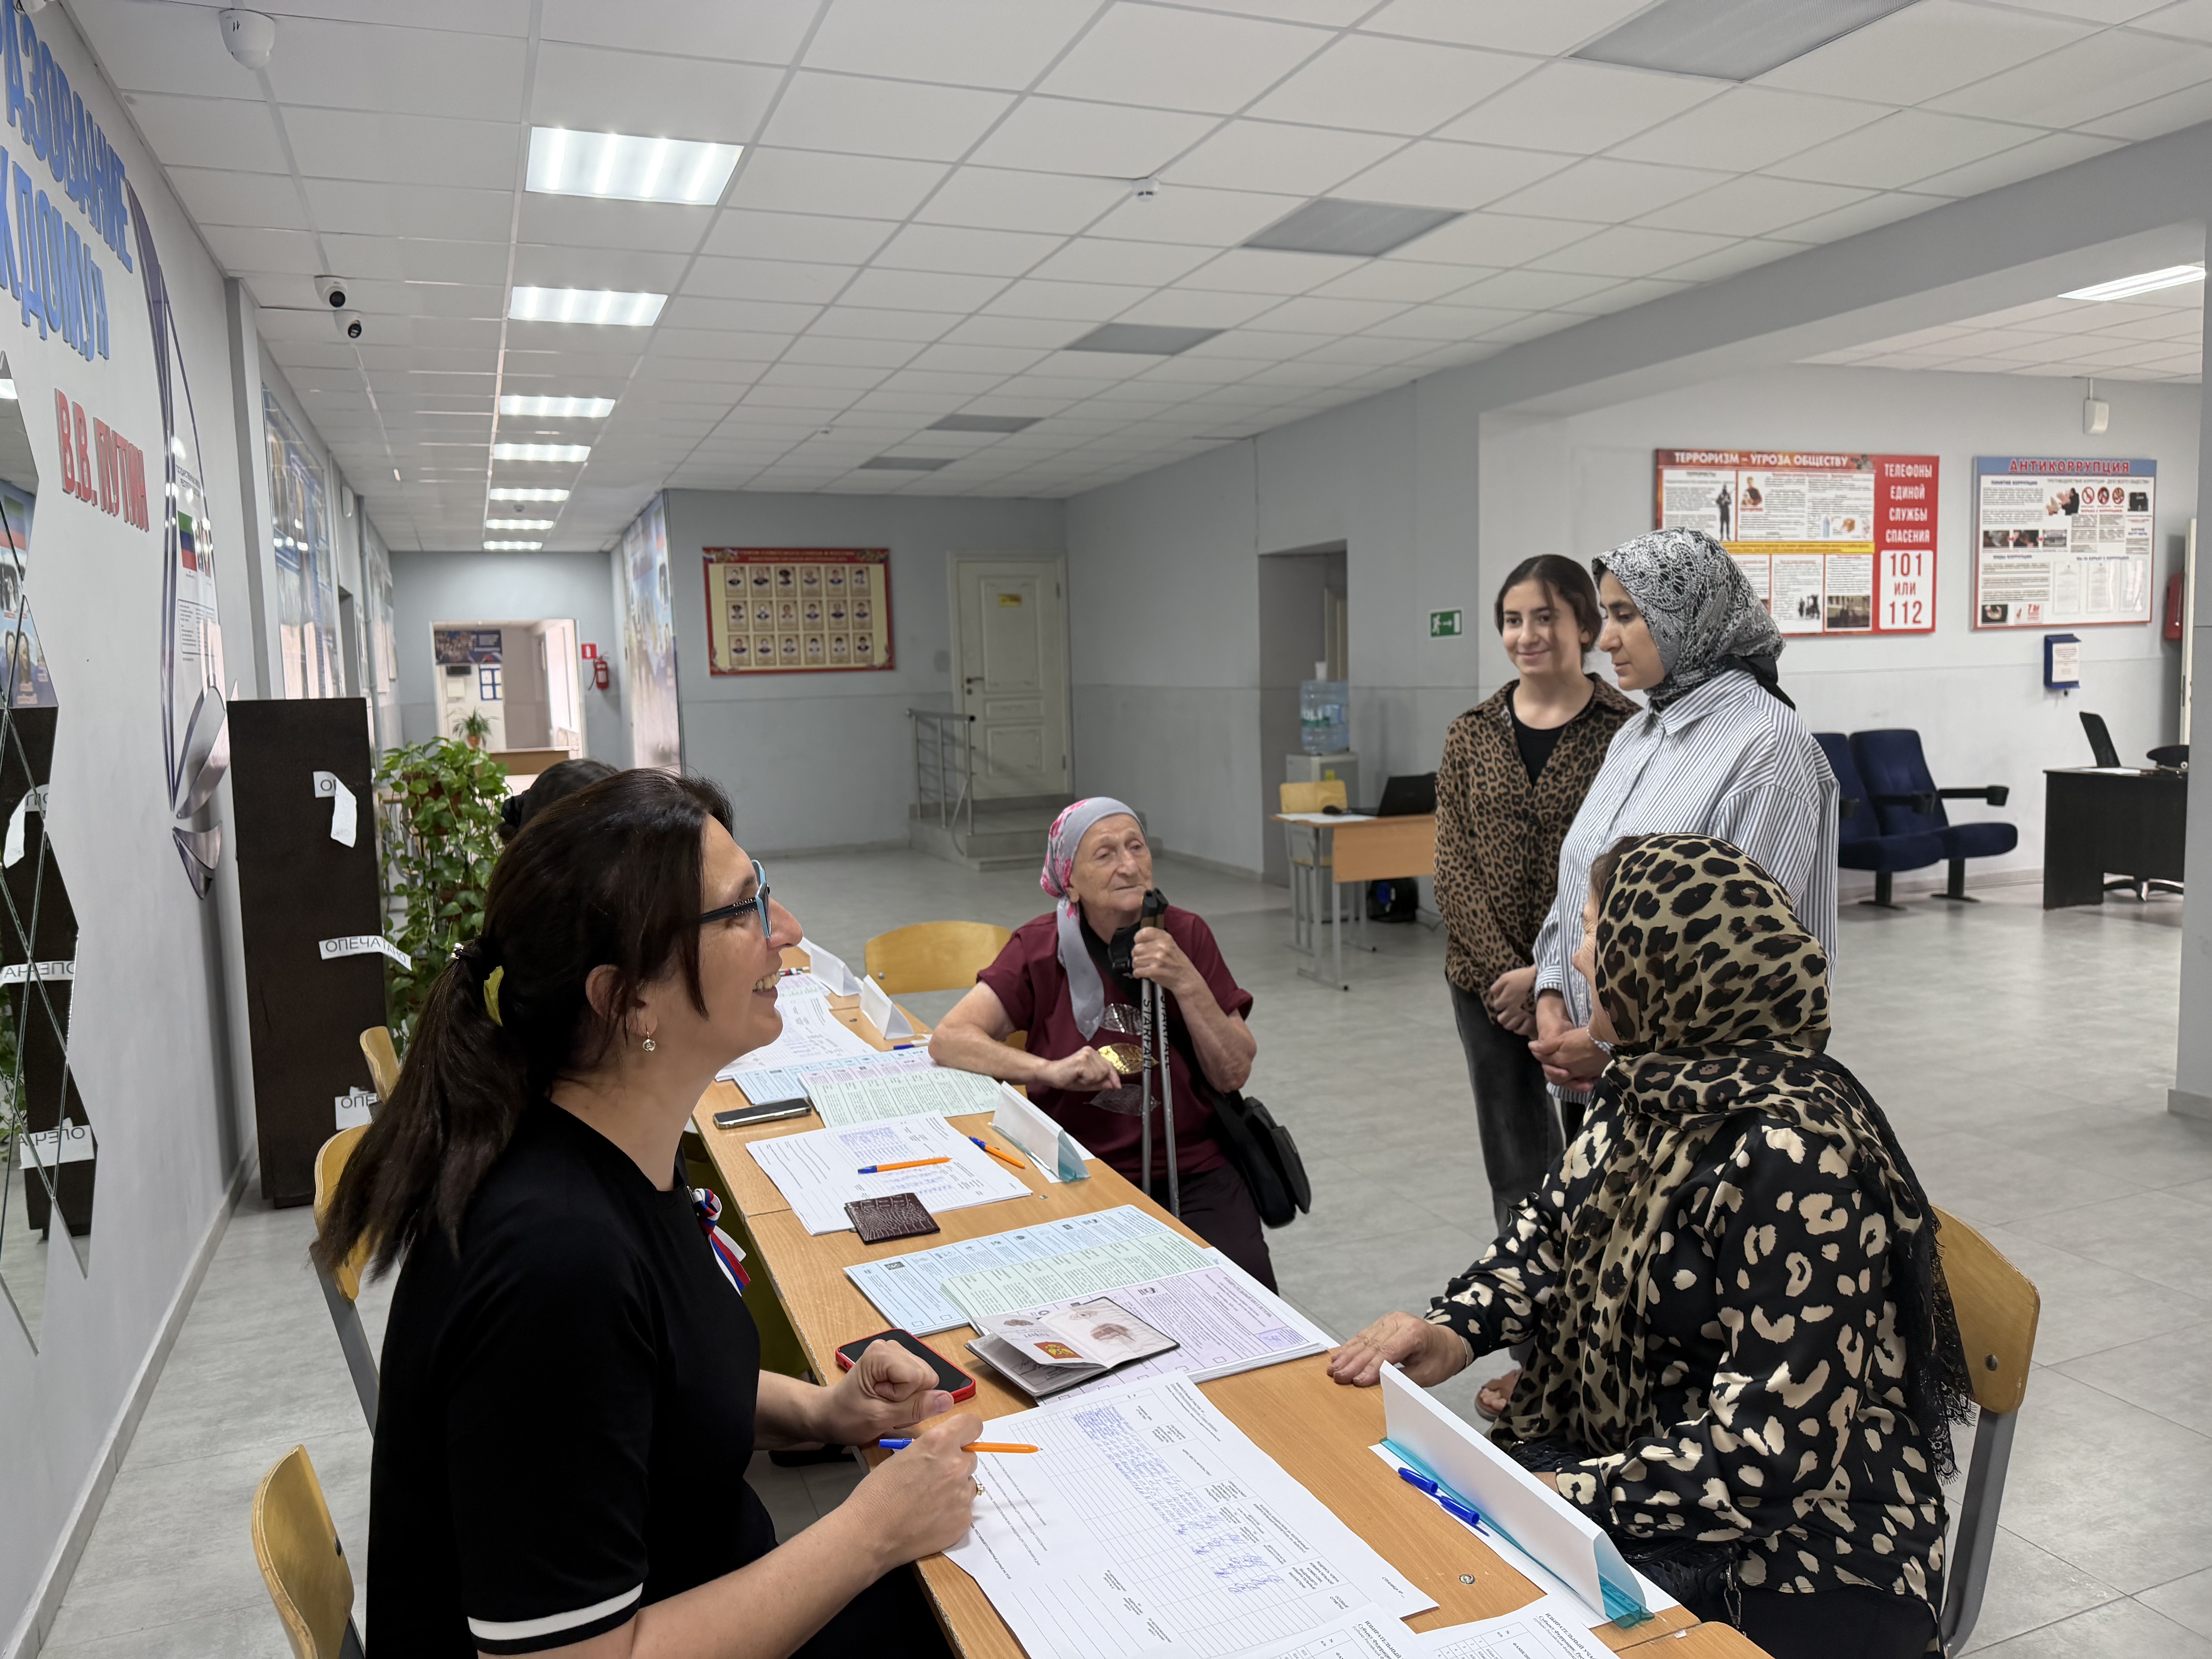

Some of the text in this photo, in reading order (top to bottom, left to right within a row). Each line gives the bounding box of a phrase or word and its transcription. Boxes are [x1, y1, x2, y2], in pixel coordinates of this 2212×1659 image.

[1674, 452, 1739, 464] ТЕРРОРИЗМ
[1750, 453, 1791, 465] УГРОЗА
[1793, 455, 1848, 467] ОБЩЕСТВУ
[2009, 459, 2130, 474] АНТИКОРРУПЦИЯ
[1884, 464, 1932, 478] ТЕЛЕФОНЫ
[1890, 484, 1925, 501] ЕДИНОЙ
[1889, 507, 1927, 522] СЛУЖБЫ
[1886, 529, 1930, 543] СПАСЕНИЯ
[1890, 553, 1922, 577] 101
[1894, 581, 1916, 596] ИЛИ
[1889, 600, 1922, 625] 112
[320, 779, 336, 792] О
[325, 937, 406, 964] ОПЕЧАТАНО
[1143, 999, 1152, 1072] STARFALL
